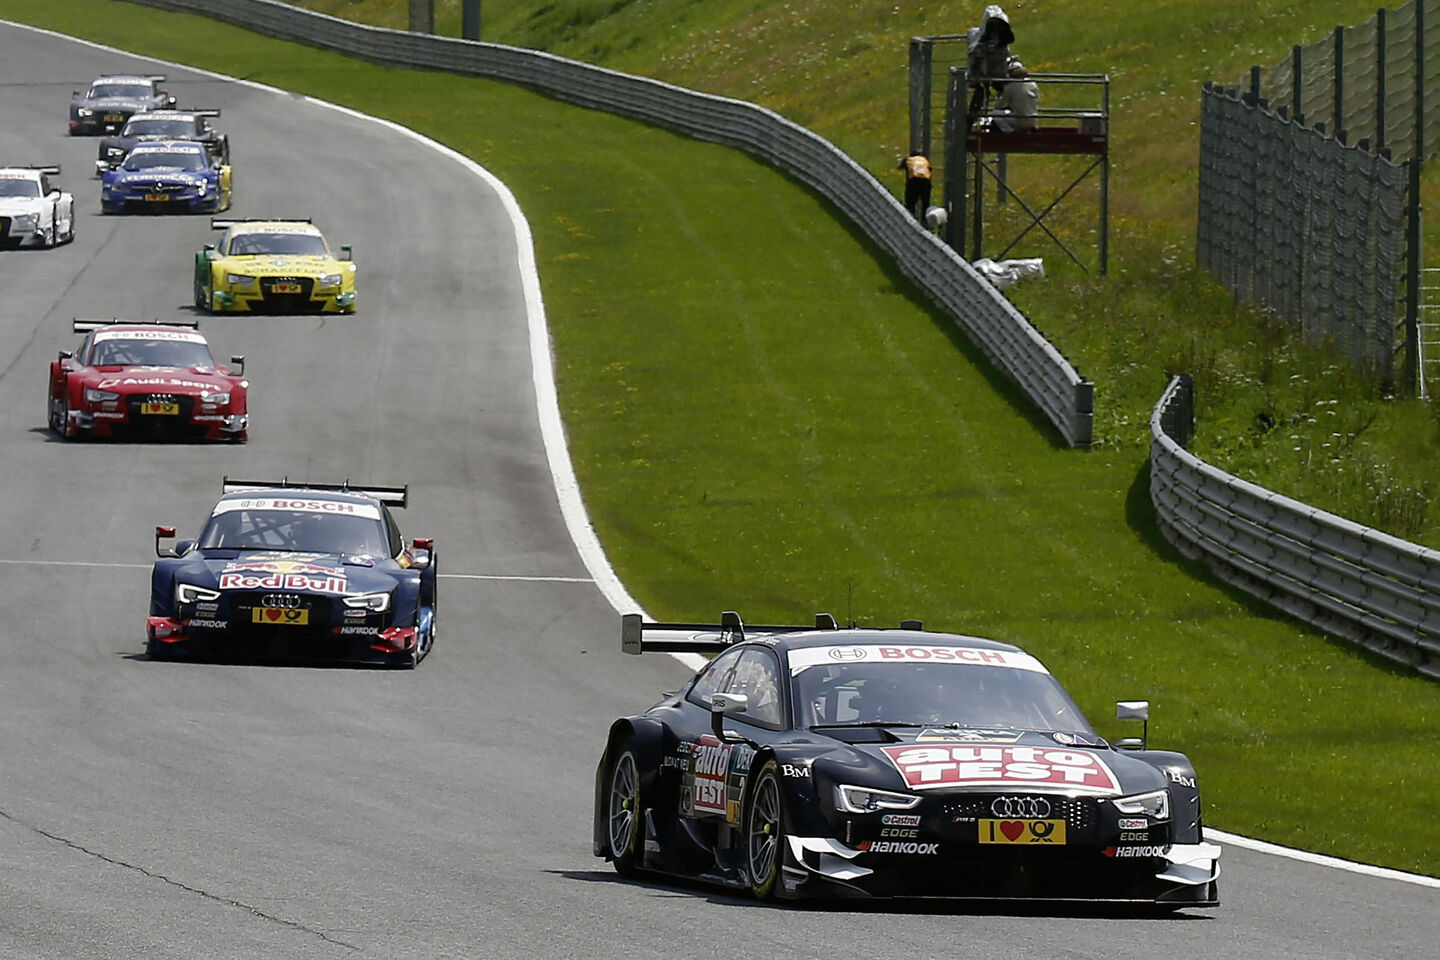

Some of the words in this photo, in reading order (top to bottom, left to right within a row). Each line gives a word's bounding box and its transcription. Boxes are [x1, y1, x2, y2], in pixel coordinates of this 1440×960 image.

[134, 330, 189, 340] BOSCH
[123, 377, 166, 385] Audi
[272, 500, 354, 512] BOSCH
[221, 574, 282, 589] Red
[286, 574, 346, 592] Bull
[878, 646, 1007, 664] BOSCH
[694, 742, 729, 777] auto
[896, 746, 1095, 766] auto
[904, 761, 1099, 783] TEST
[694, 777, 725, 805] TEST
[891, 815, 919, 825] Castrol
[880, 828, 920, 838] EDGE
[1120, 832, 1150, 841] EDGE
